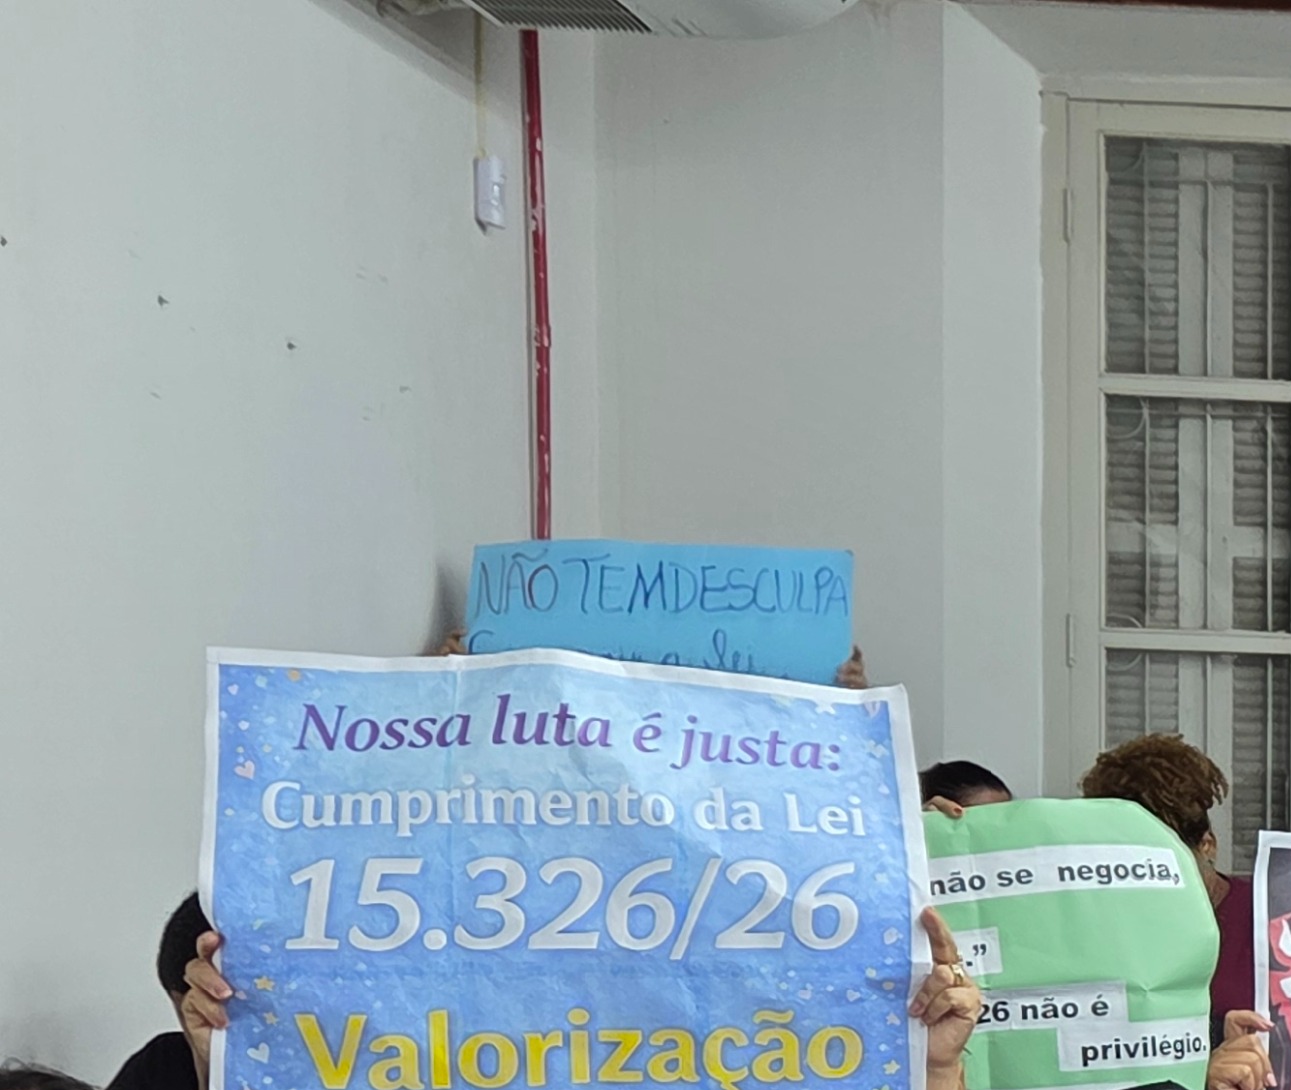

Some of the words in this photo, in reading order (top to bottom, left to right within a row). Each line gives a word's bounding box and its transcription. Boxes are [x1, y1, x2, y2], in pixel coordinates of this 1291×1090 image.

[474, 548, 559, 617] NÃO
[294, 703, 472, 753] Nossa
[492, 694, 612, 749] luta
[632, 712, 661, 755] é
[670, 715, 842, 771] justa:
[260, 775, 675, 838] Cumprimento
[694, 788, 763, 834] da
[786, 793, 866, 837] Lei
[284, 855, 861, 961] 15.326/26
[930, 870, 987, 896] não
[997, 866, 1034, 888] se
[1057, 857, 1181, 885] negocia,
[1021, 997, 1079, 1021] não
[1091, 994, 1110, 1017] é
[1081, 1032, 1207, 1066] privilégio.
